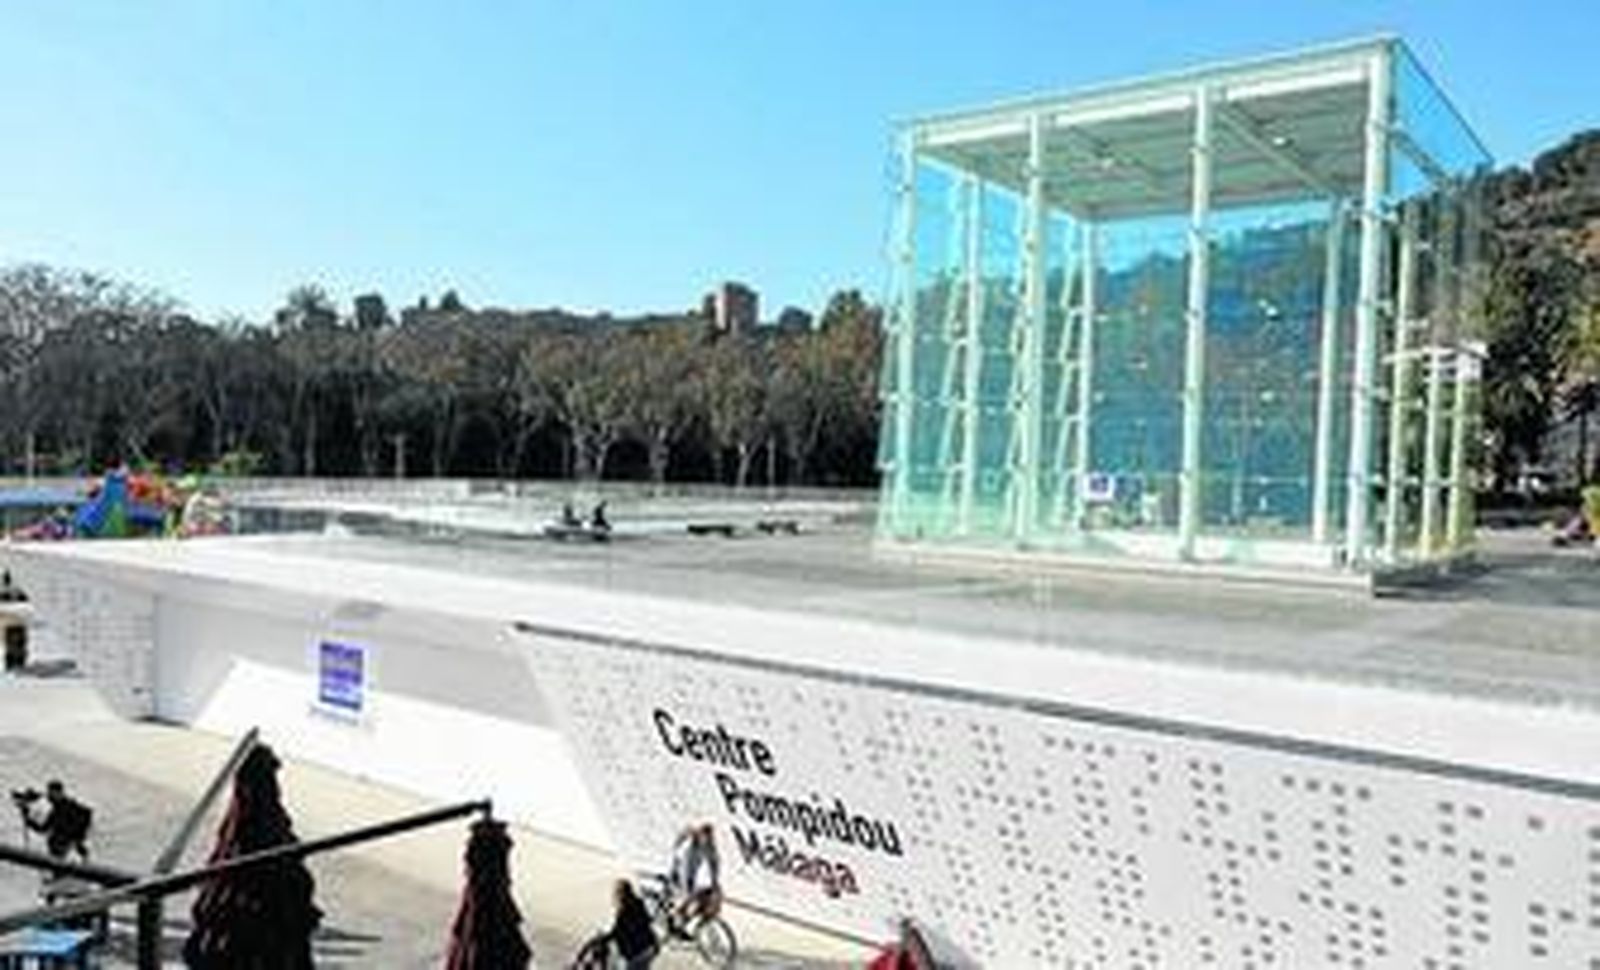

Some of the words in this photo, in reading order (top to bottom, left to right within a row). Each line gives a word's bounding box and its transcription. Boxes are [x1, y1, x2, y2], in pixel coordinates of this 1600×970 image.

[653, 707, 776, 776] Centre
[715, 772, 903, 856] Pompidou
[732, 825, 860, 898] Málaga
